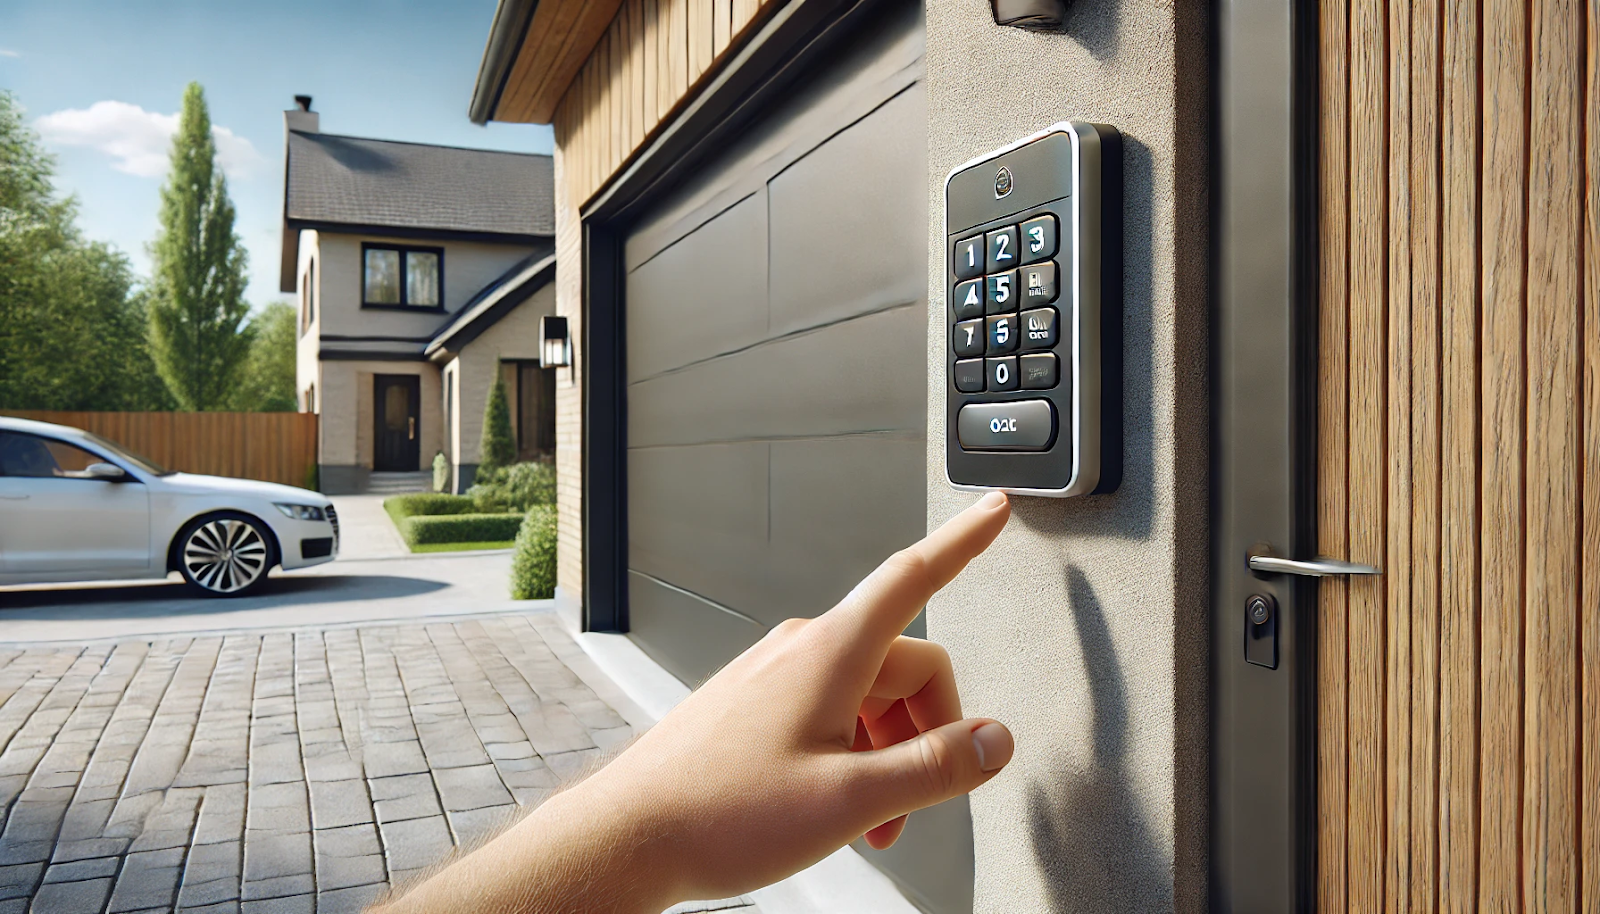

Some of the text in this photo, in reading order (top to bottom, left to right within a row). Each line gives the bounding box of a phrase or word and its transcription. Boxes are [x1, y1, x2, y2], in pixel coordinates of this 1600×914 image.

[967, 226, 1045, 267] 1 2 3
[995, 275, 1010, 303] 5
[963, 326, 974, 347] 7
